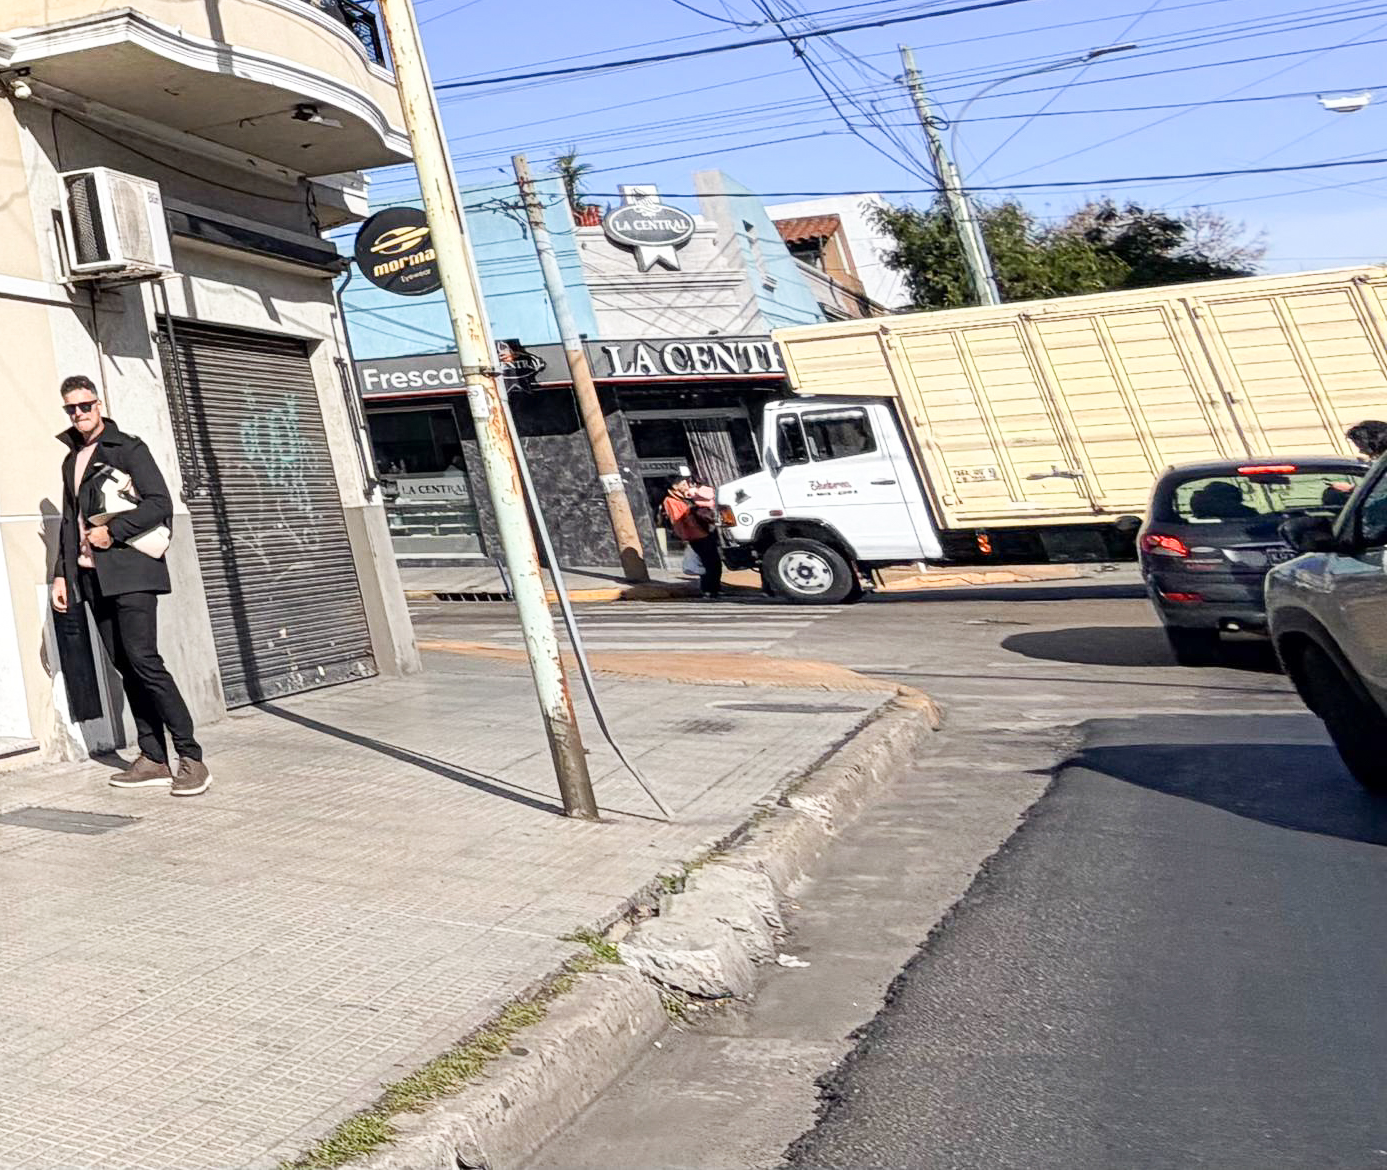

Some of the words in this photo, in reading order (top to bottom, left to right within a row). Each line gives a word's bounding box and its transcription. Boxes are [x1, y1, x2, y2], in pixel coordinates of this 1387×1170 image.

[614, 220, 631, 231] LA
[632, 218, 689, 234] CENTRAL
[373, 248, 436, 277] morma
[604, 343, 662, 377] LA
[401, 485, 416, 495] LA
